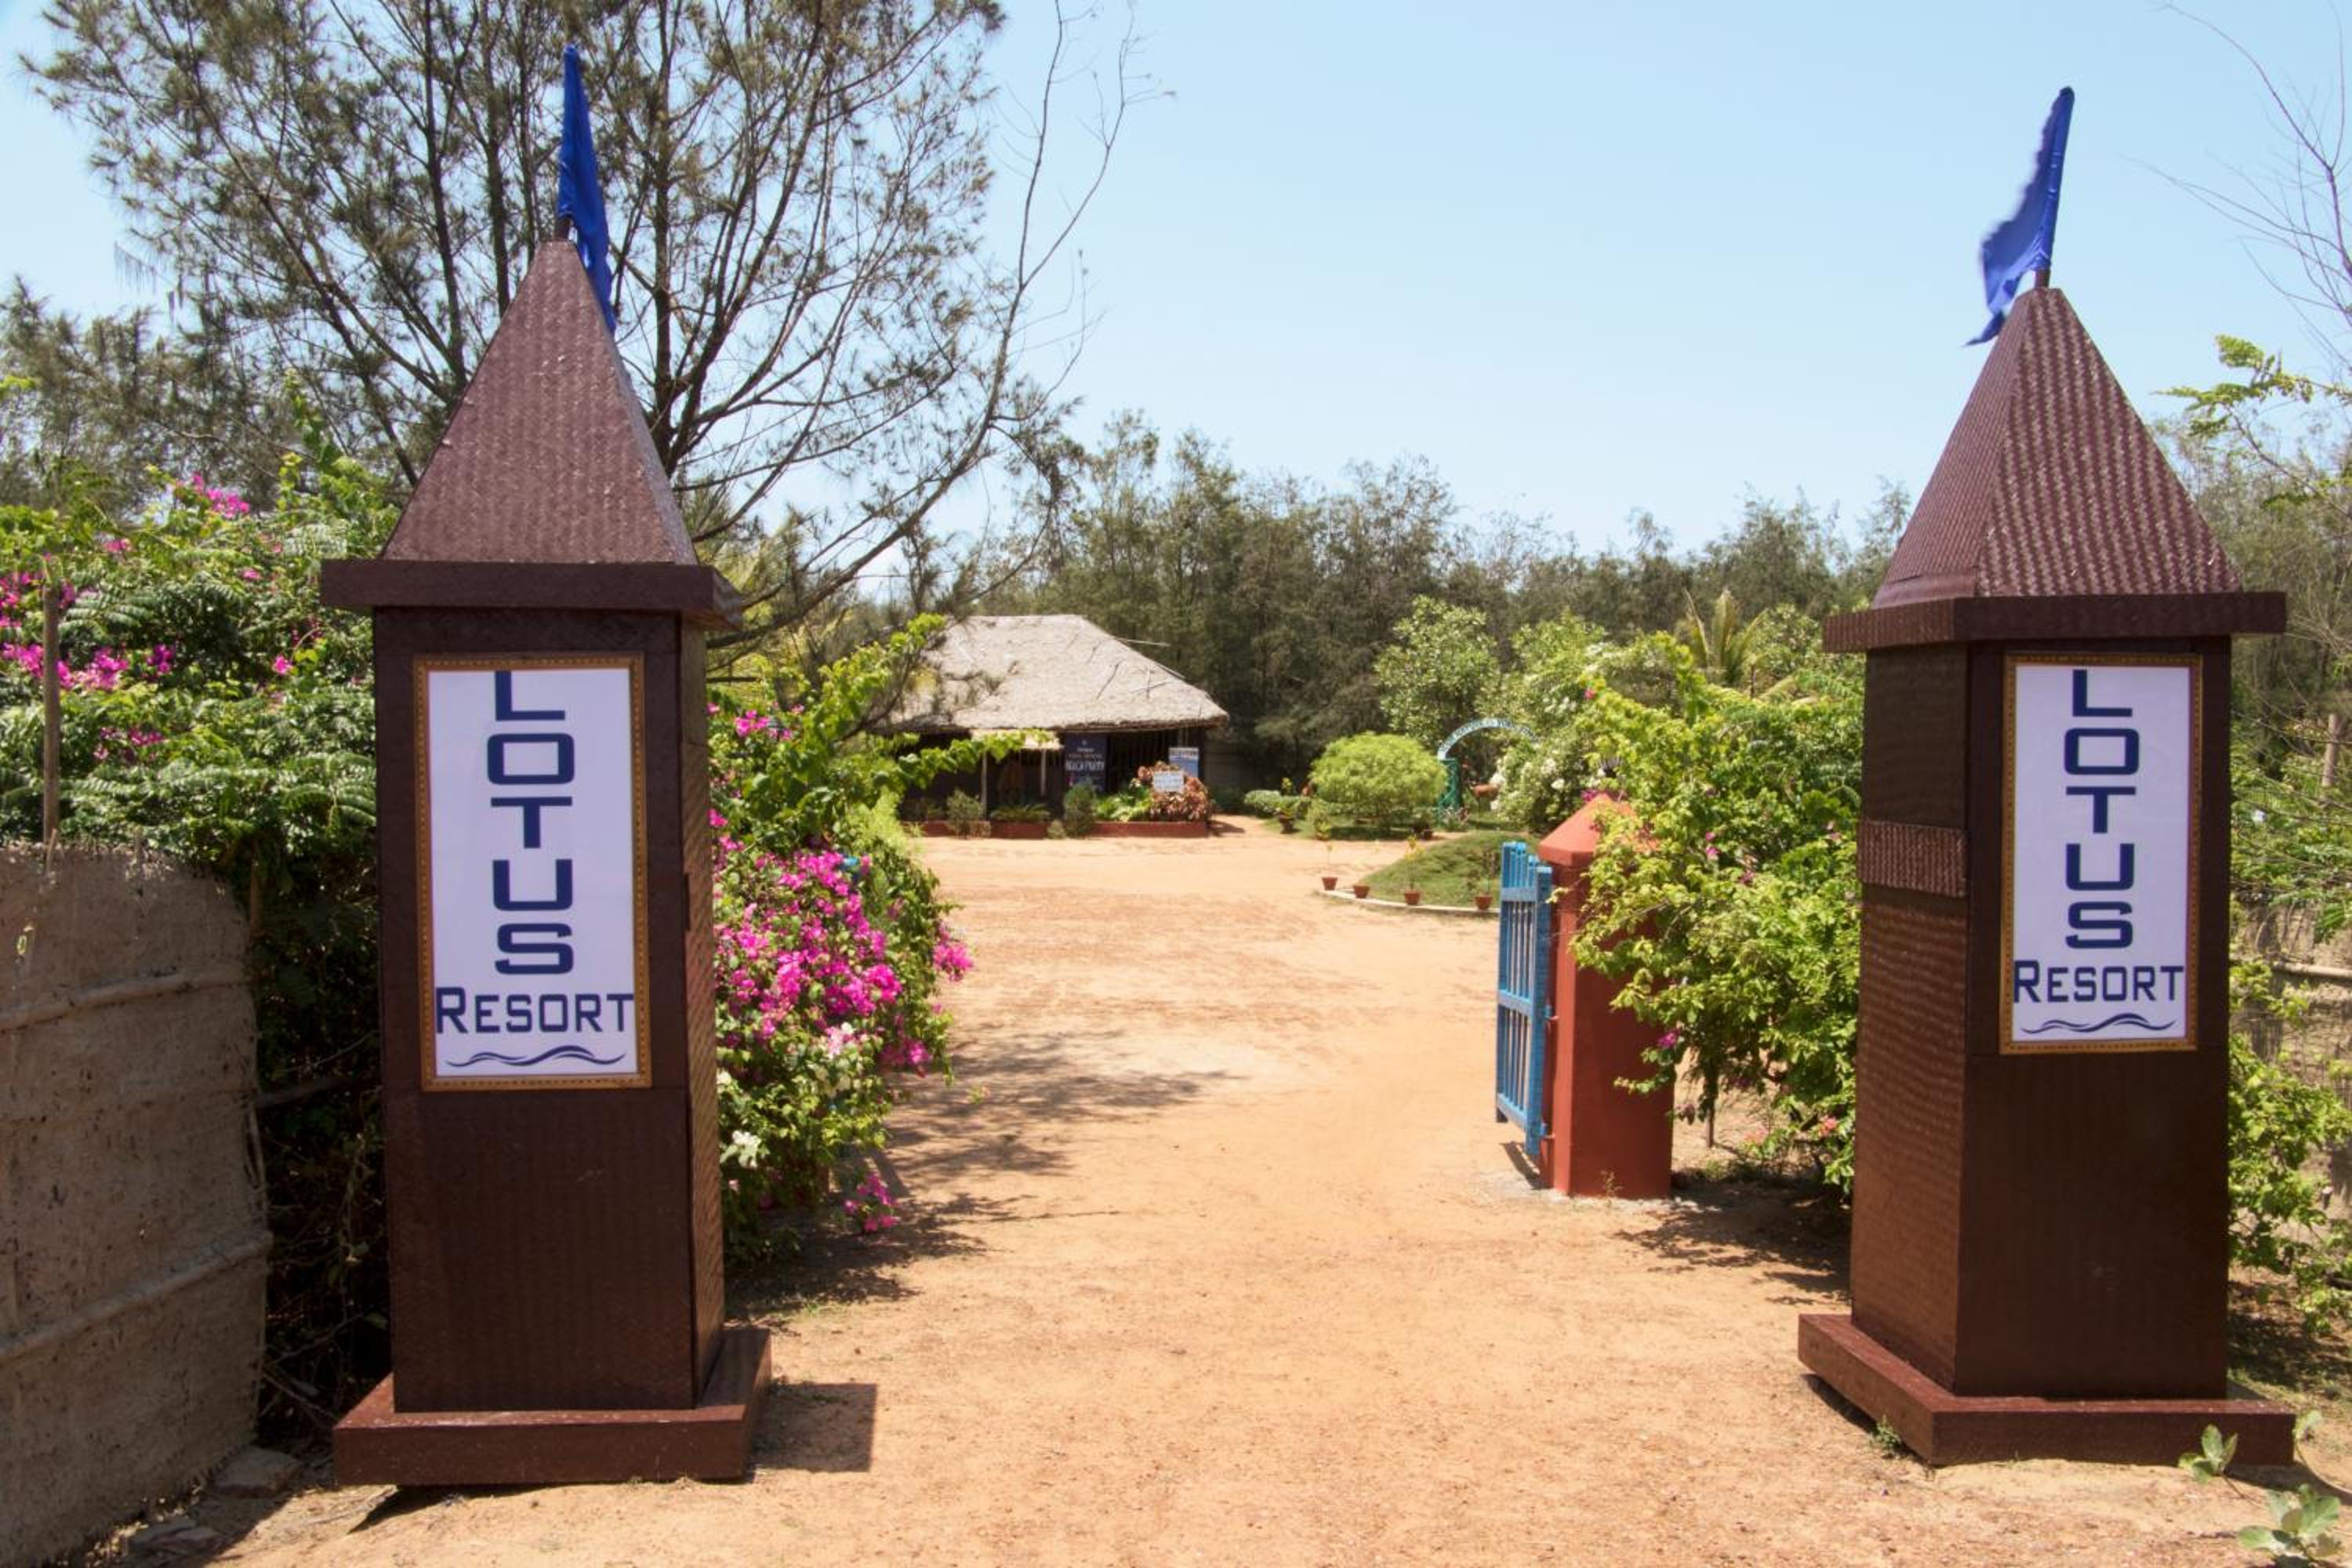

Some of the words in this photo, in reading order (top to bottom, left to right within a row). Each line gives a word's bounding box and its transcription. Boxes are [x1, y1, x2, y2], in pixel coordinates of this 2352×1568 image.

[486, 670, 575, 975] LOTUS
[2063, 669, 2140, 949] LOTUS
[436, 986, 634, 1033] RESORT
[2013, 960, 2185, 1003] RESORT
